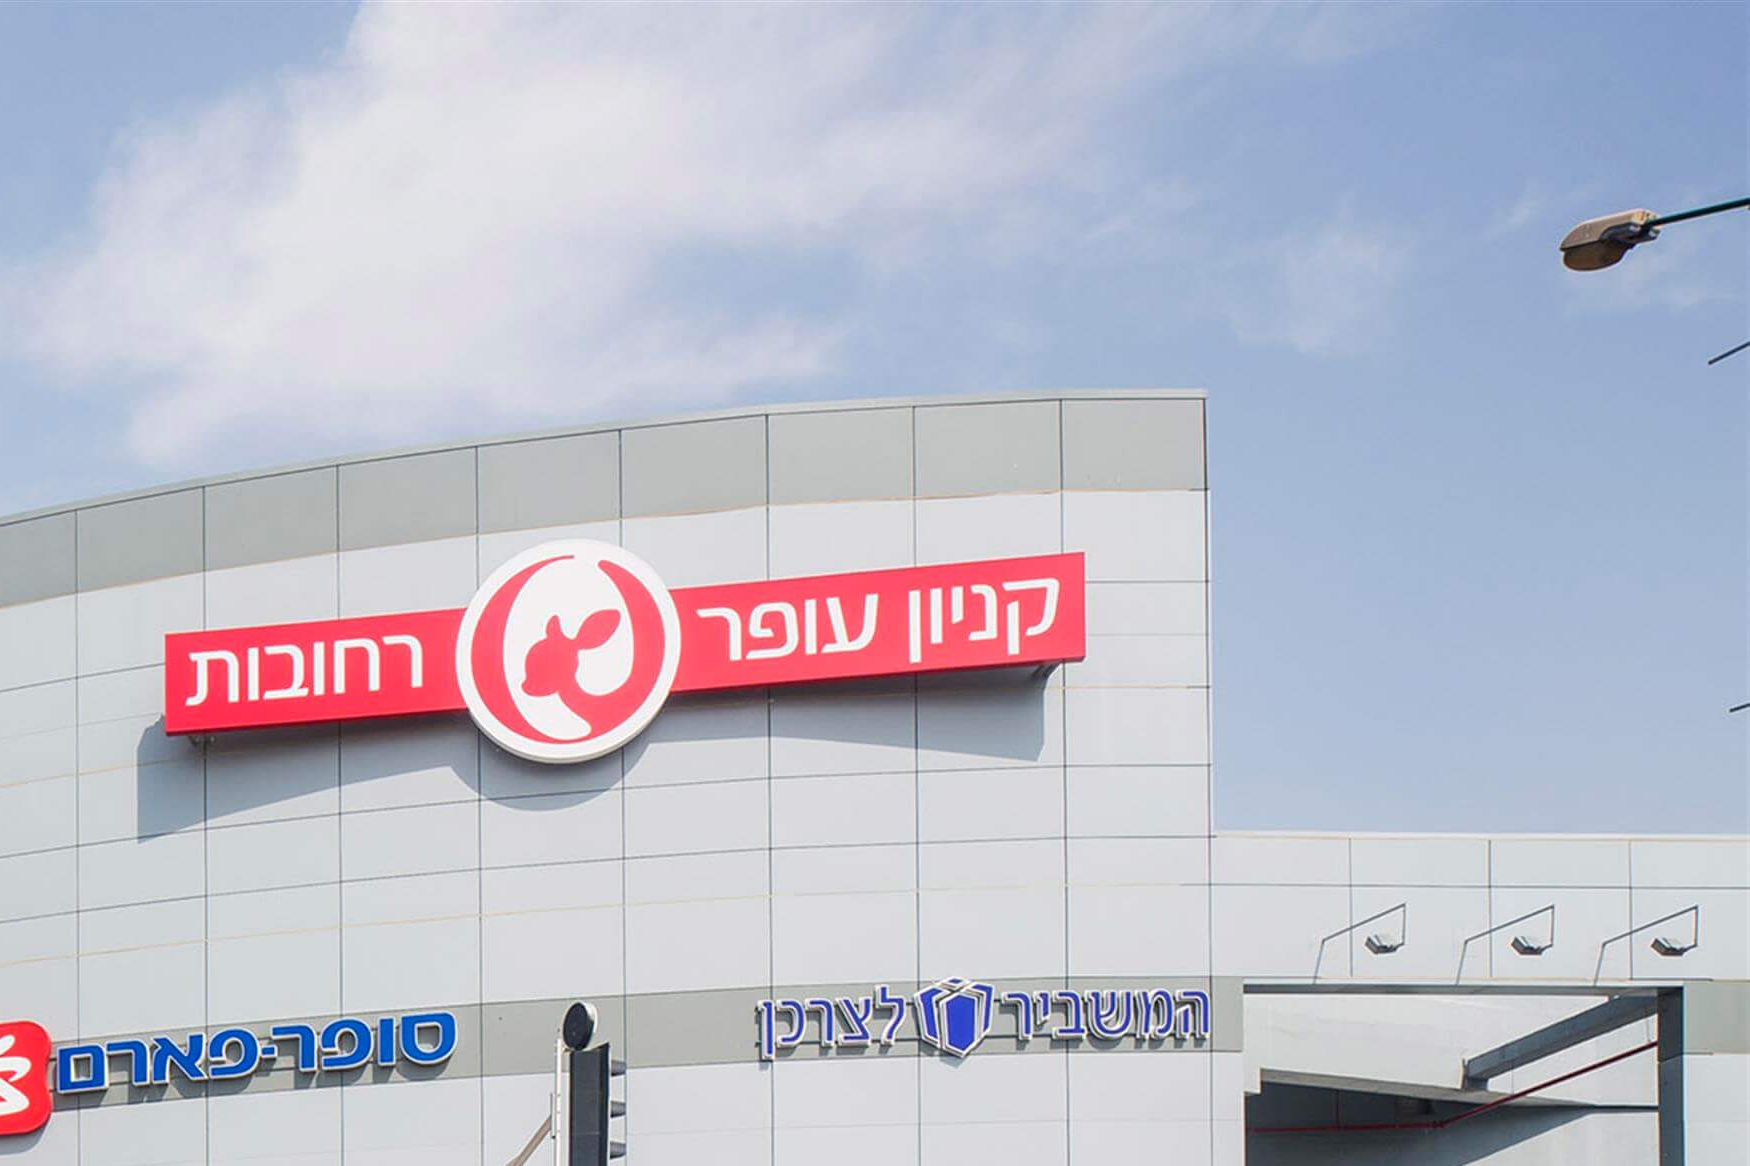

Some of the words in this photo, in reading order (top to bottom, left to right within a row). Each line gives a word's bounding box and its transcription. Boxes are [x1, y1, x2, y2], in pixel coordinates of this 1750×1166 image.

[696, 592, 879, 662] עופר
[907, 577, 1061, 665] קניון
[184, 633, 424, 707] רחובות
[757, 983, 907, 1061] לצרכן
[1000, 986, 1211, 1041] המשביר
[56, 1010, 458, 1095] סופר-פארם
